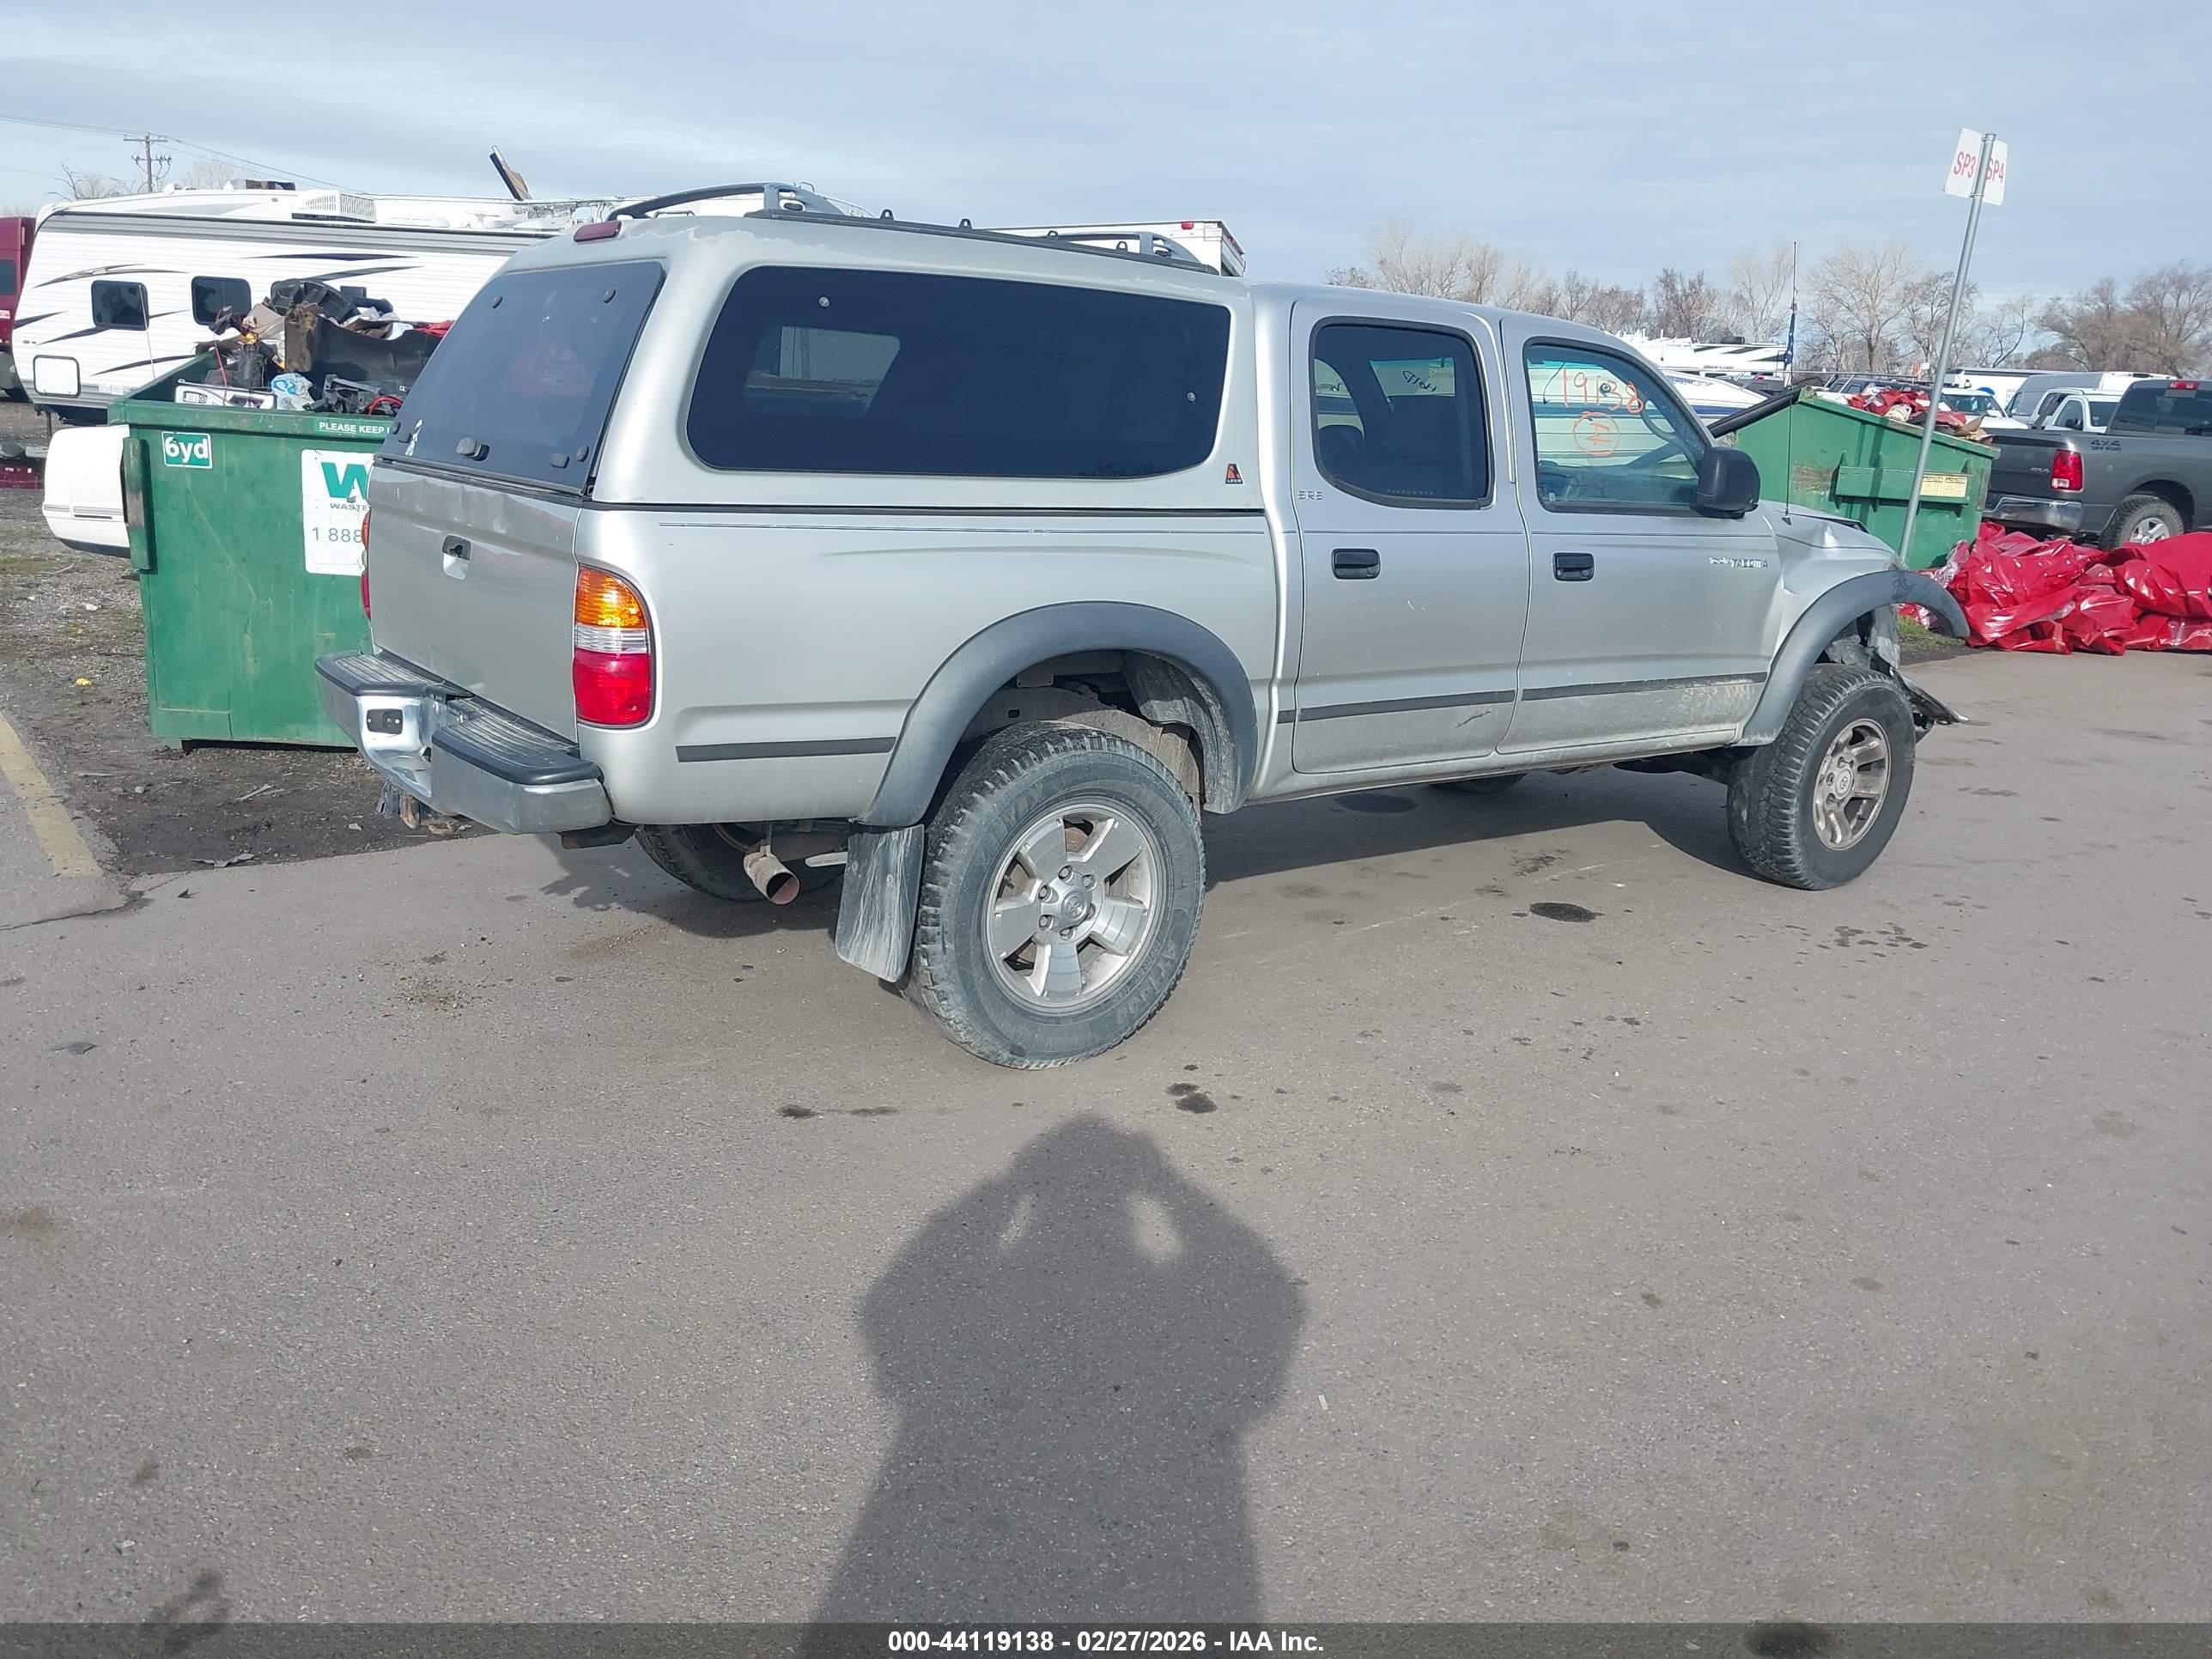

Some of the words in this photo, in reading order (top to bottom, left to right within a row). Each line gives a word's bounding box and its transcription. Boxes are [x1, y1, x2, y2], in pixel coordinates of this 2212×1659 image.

[1954, 151, 1976, 179] SP3
[1985, 157, 2004, 184] SP4
[1563, 368, 1644, 413] 19138
[319, 422, 357, 432] PLEASE
[359, 425, 384, 434] KEEP
[165, 436, 209, 463] 6yd
[312, 526, 319, 541] 1
[328, 527, 363, 543] 888
